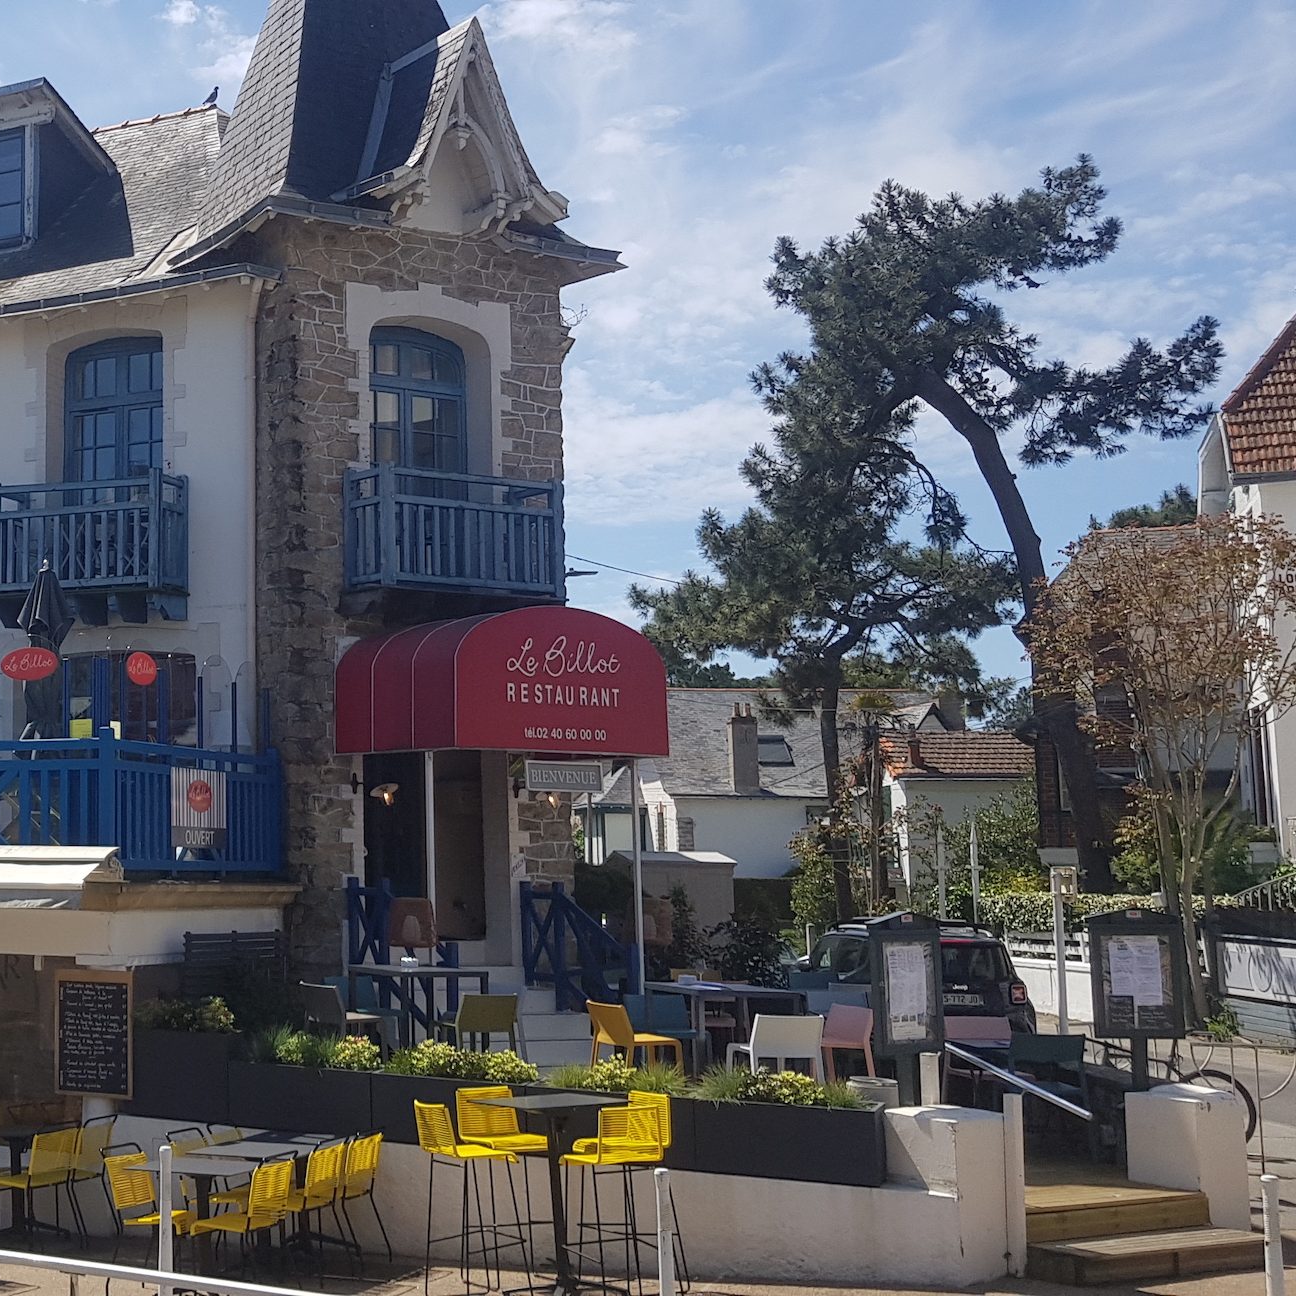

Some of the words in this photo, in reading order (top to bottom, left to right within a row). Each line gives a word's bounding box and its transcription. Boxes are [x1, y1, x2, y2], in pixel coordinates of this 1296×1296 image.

[1279, 573, 1296, 583] LO
[4, 656, 19, 672] Le
[19, 653, 53, 671] Billot
[506, 637, 539, 677] Le
[543, 635, 621, 678] Billot
[506, 682, 620, 708] RESTAURANT
[524, 727, 548, 739] tél.02
[551, 728, 563, 739] 40
[565, 728, 577, 740] 60
[580, 729, 592, 740] 00
[594, 730, 607, 741] 00
[530, 769, 597, 785] BIENVENUE
[185, 830, 215, 845] OUVERT
